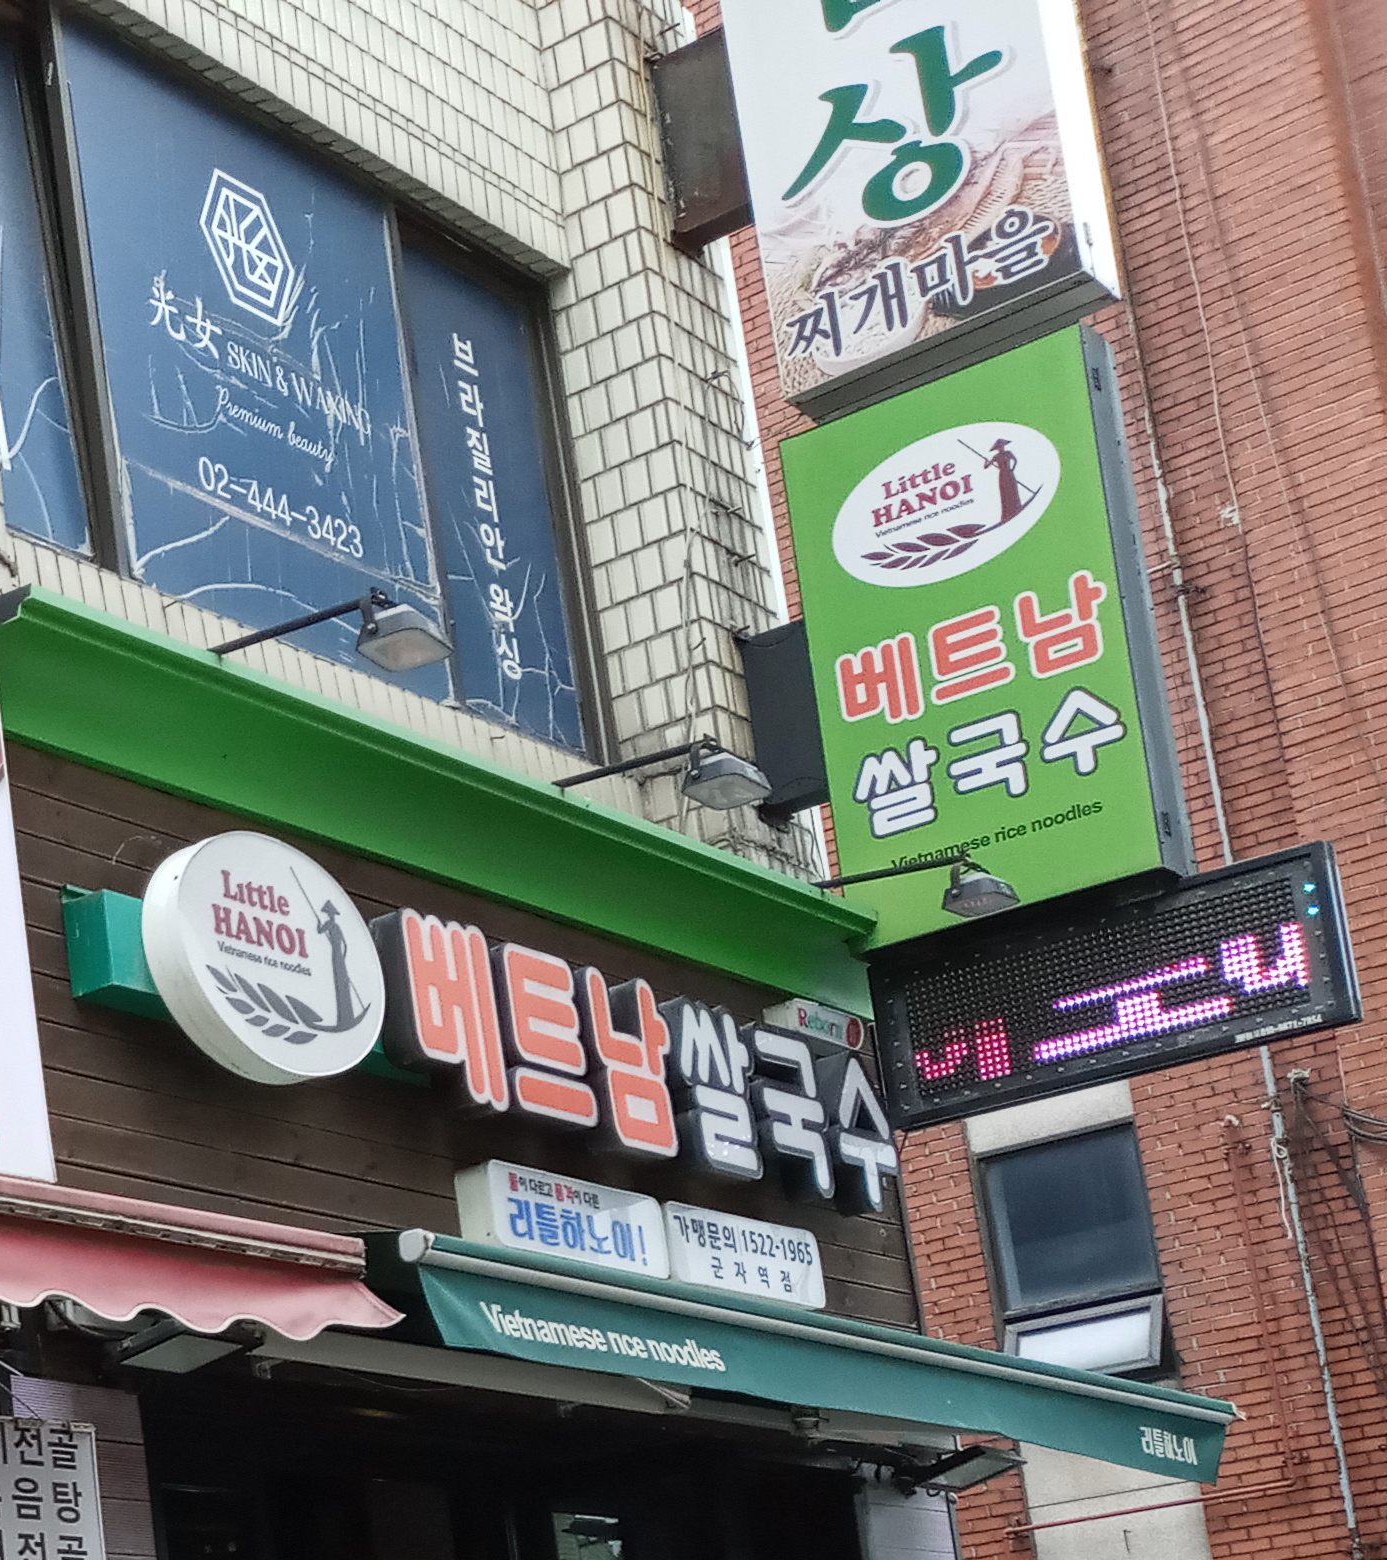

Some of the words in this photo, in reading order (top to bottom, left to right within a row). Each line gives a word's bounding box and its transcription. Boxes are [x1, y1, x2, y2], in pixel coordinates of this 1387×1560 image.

[782, 0, 1004, 223] 상
[785, 207, 1055, 360] 찌개마을
[227, 340, 273, 387] SKIN
[215, 384, 284, 440] Premium
[287, 421, 334, 473] beauty
[198, 455, 364, 559] 02-444-3423
[870, 473, 974, 528] HANOI
[881, 461, 956, 501] Little
[923, 510, 940, 521] rice
[940, 498, 975, 515] noodles
[488, 583, 524, 682] 왁싱
[836, 571, 1107, 723] 베트남
[853, 686, 1126, 839] 쌀국수
[993, 824, 1028, 844] rice
[1030, 800, 1104, 834] noodles
[220, 869, 291, 917] Little
[211, 903, 310, 959] HANOI
[507, 1195, 649, 1268] 리틀하노이!
[672, 1213, 739, 1255] 가맹문의
[740, 1228, 815, 1268] 1522-1965
[479, 1300, 608, 1354] Vietnamese
[610, 1331, 649, 1360] rice
[648, 1339, 726, 1374] noodles
